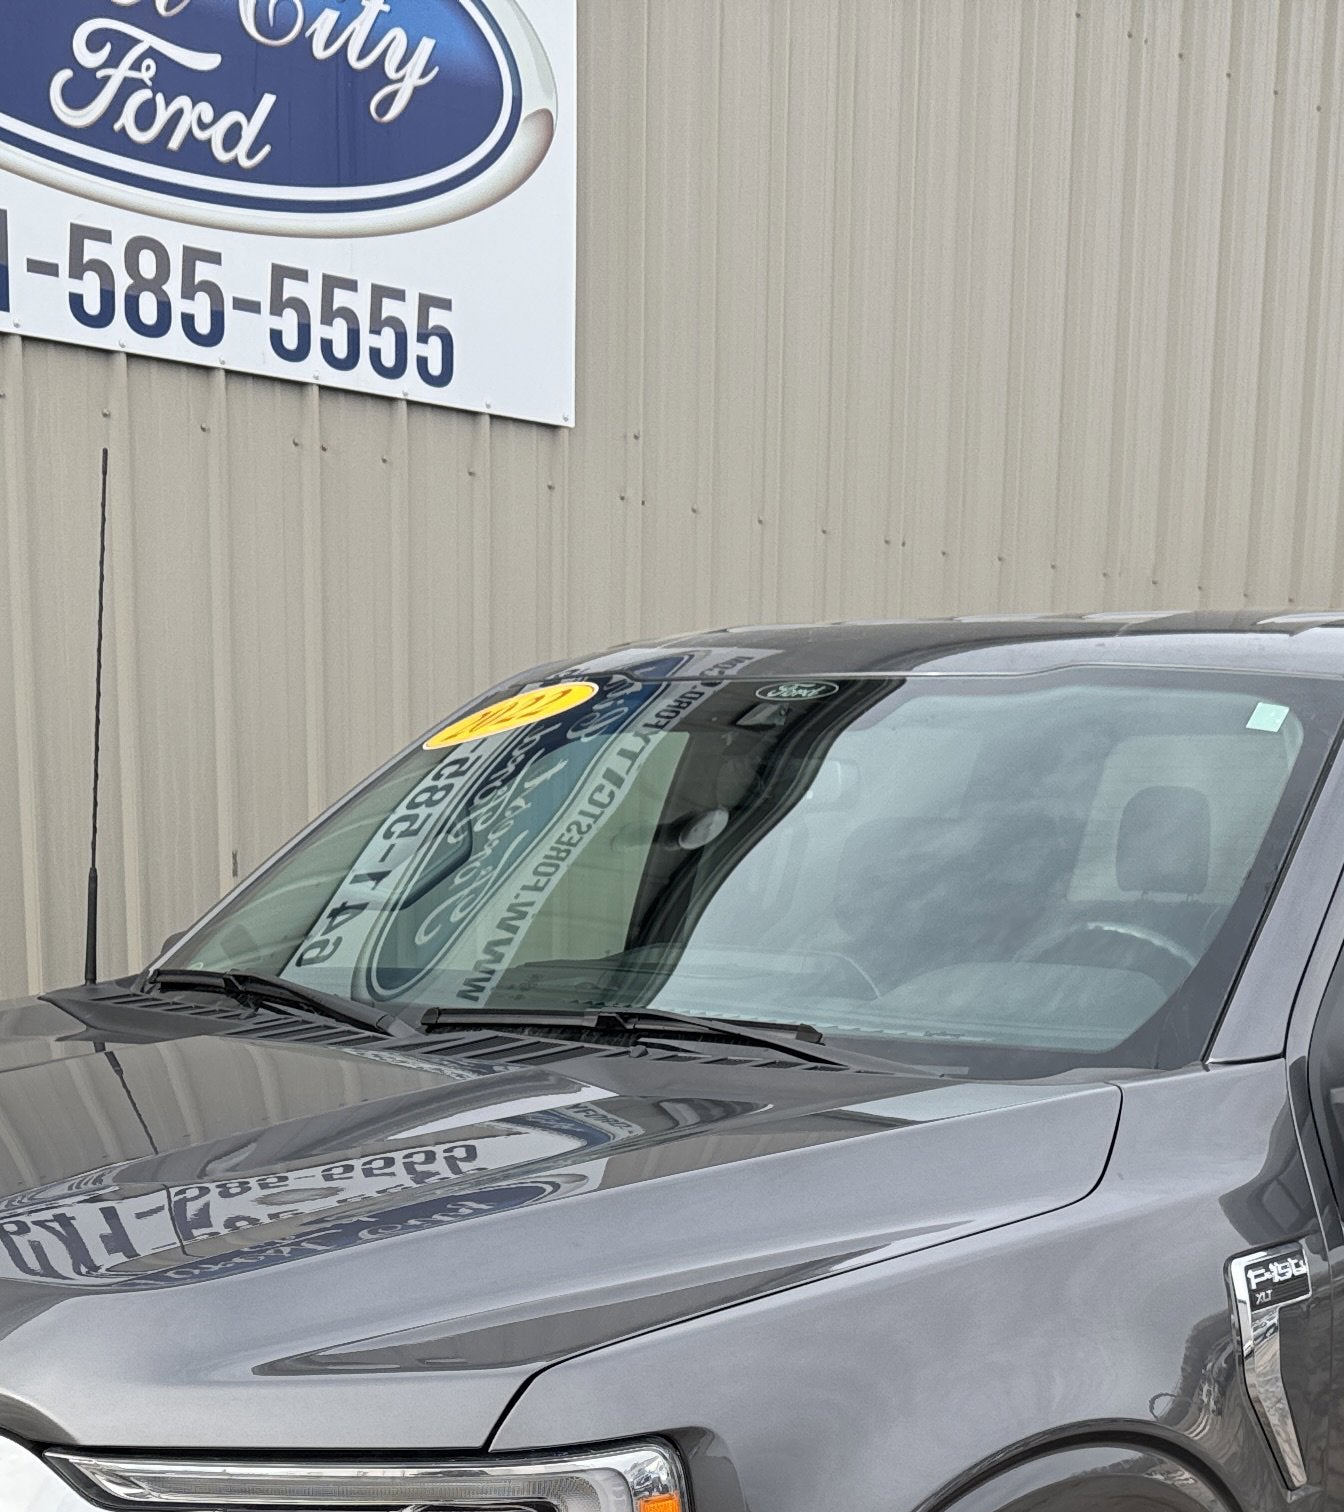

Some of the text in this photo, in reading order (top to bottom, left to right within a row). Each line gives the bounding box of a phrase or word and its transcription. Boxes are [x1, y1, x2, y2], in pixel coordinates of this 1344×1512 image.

[49, 17, 277, 169] Ford
[767, 683, 828, 698] Ford
[1247, 1257, 1307, 1289] F-150
[1255, 1290, 1273, 1305] XLT
